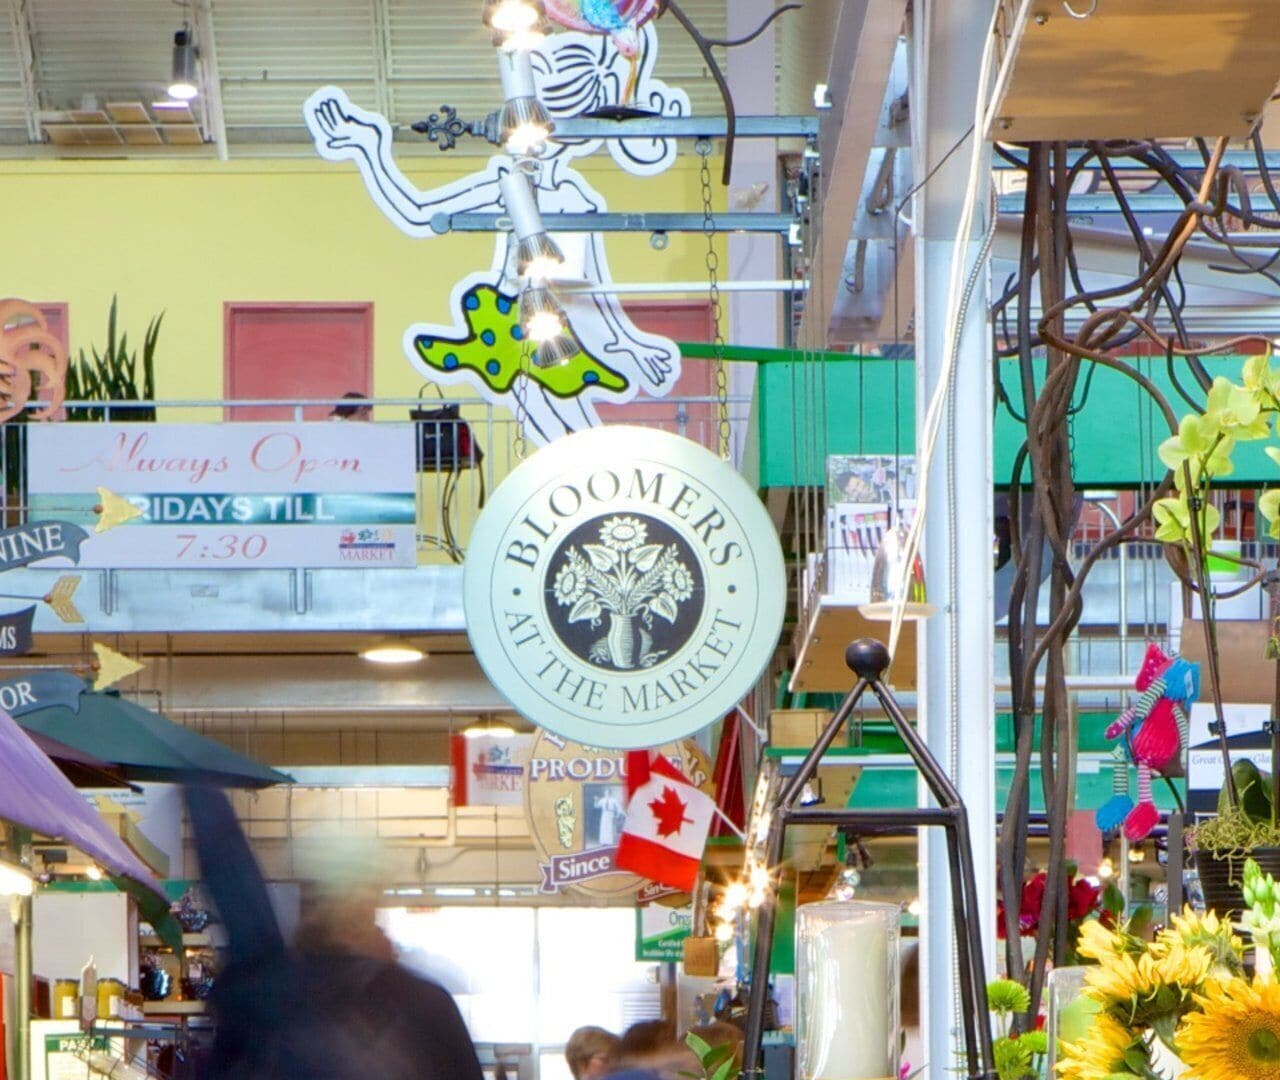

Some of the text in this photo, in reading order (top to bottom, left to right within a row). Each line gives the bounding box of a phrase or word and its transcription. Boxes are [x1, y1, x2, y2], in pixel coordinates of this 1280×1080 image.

[60, 432, 363, 484] Always Open
[125, 496, 336, 522] RIDAYS TILL
[505, 468, 742, 572] BLOOMERS
[175, 534, 268, 560] 7:30
[340, 548, 394, 561] MARKET
[505, 608, 742, 713] AT THE MARKET
[558, 853, 611, 880] Since
